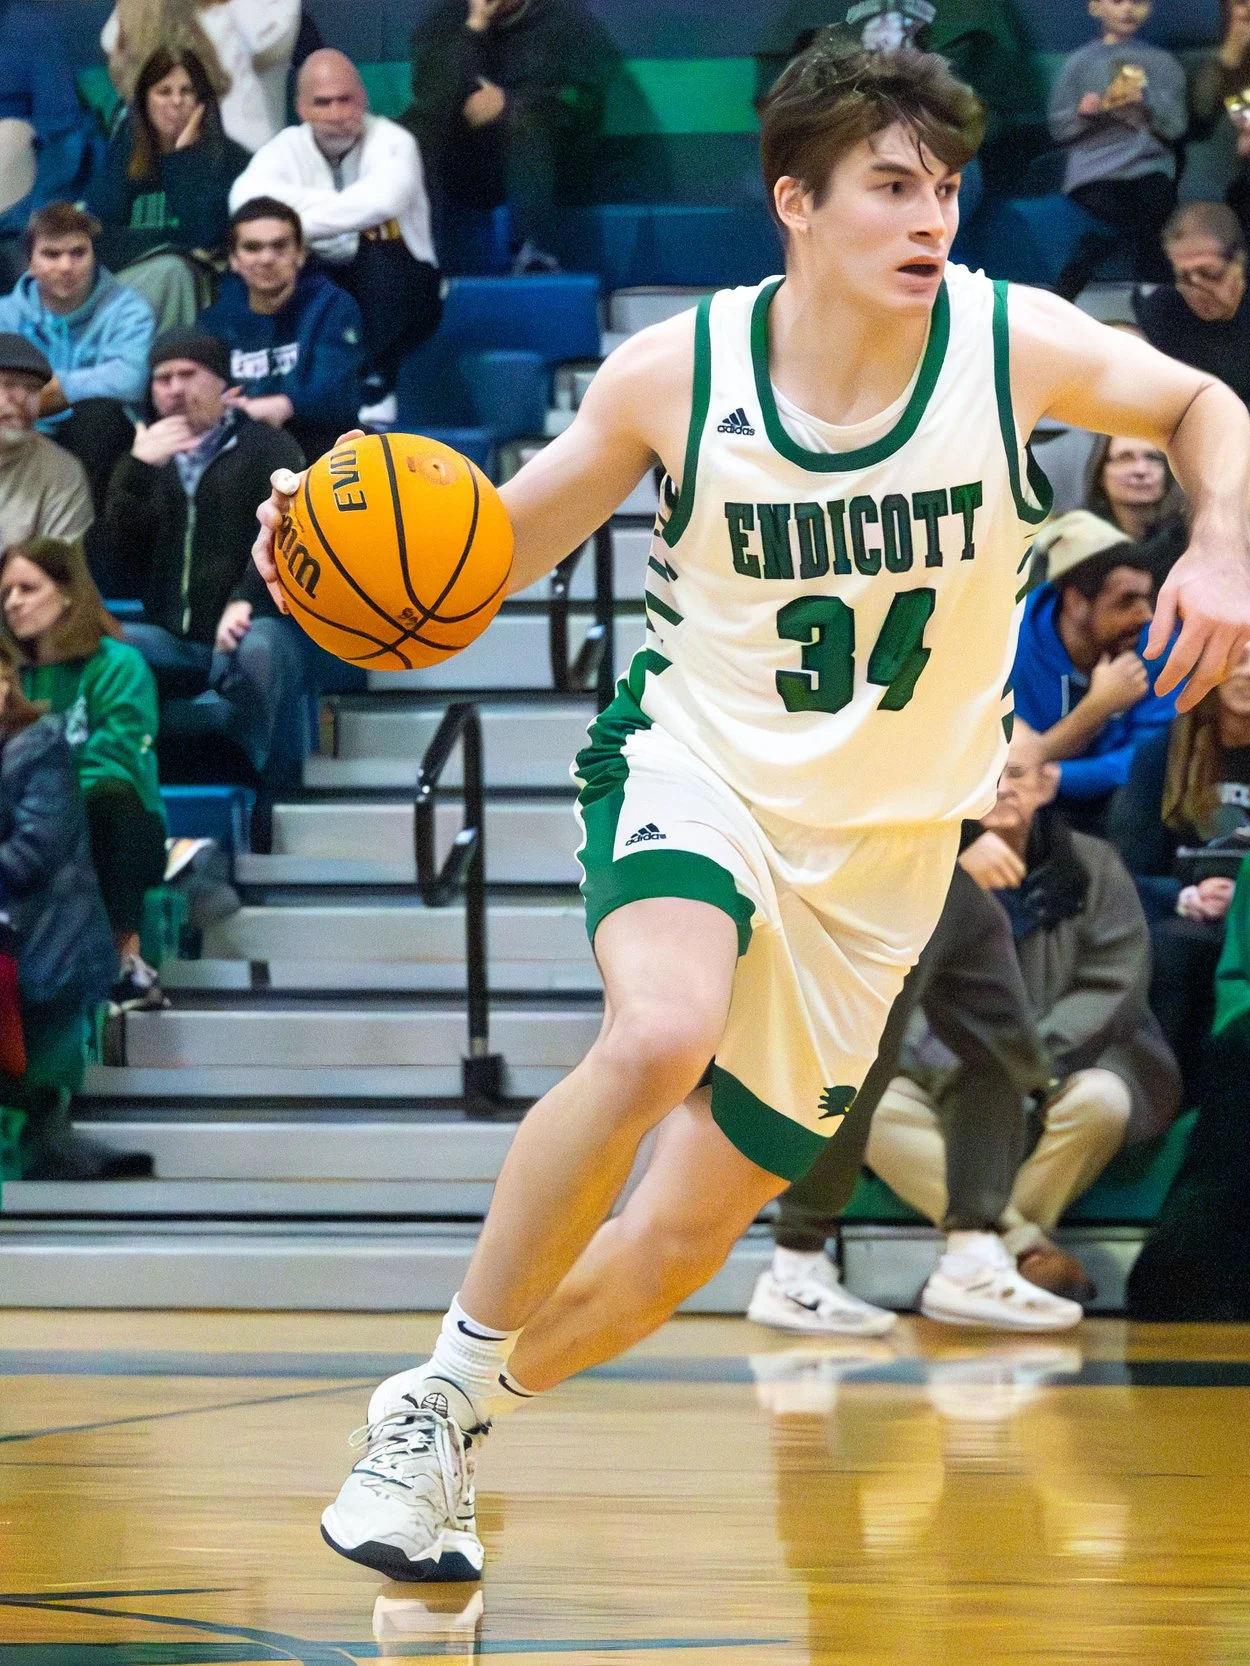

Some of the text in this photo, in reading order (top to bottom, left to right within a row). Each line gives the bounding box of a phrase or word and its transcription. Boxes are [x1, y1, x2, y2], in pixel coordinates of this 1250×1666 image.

[717, 424, 755, 436] adidas
[724, 480, 983, 579] ENDICOTT
[775, 587, 936, 714] 34
[625, 832, 667, 846] adidas
